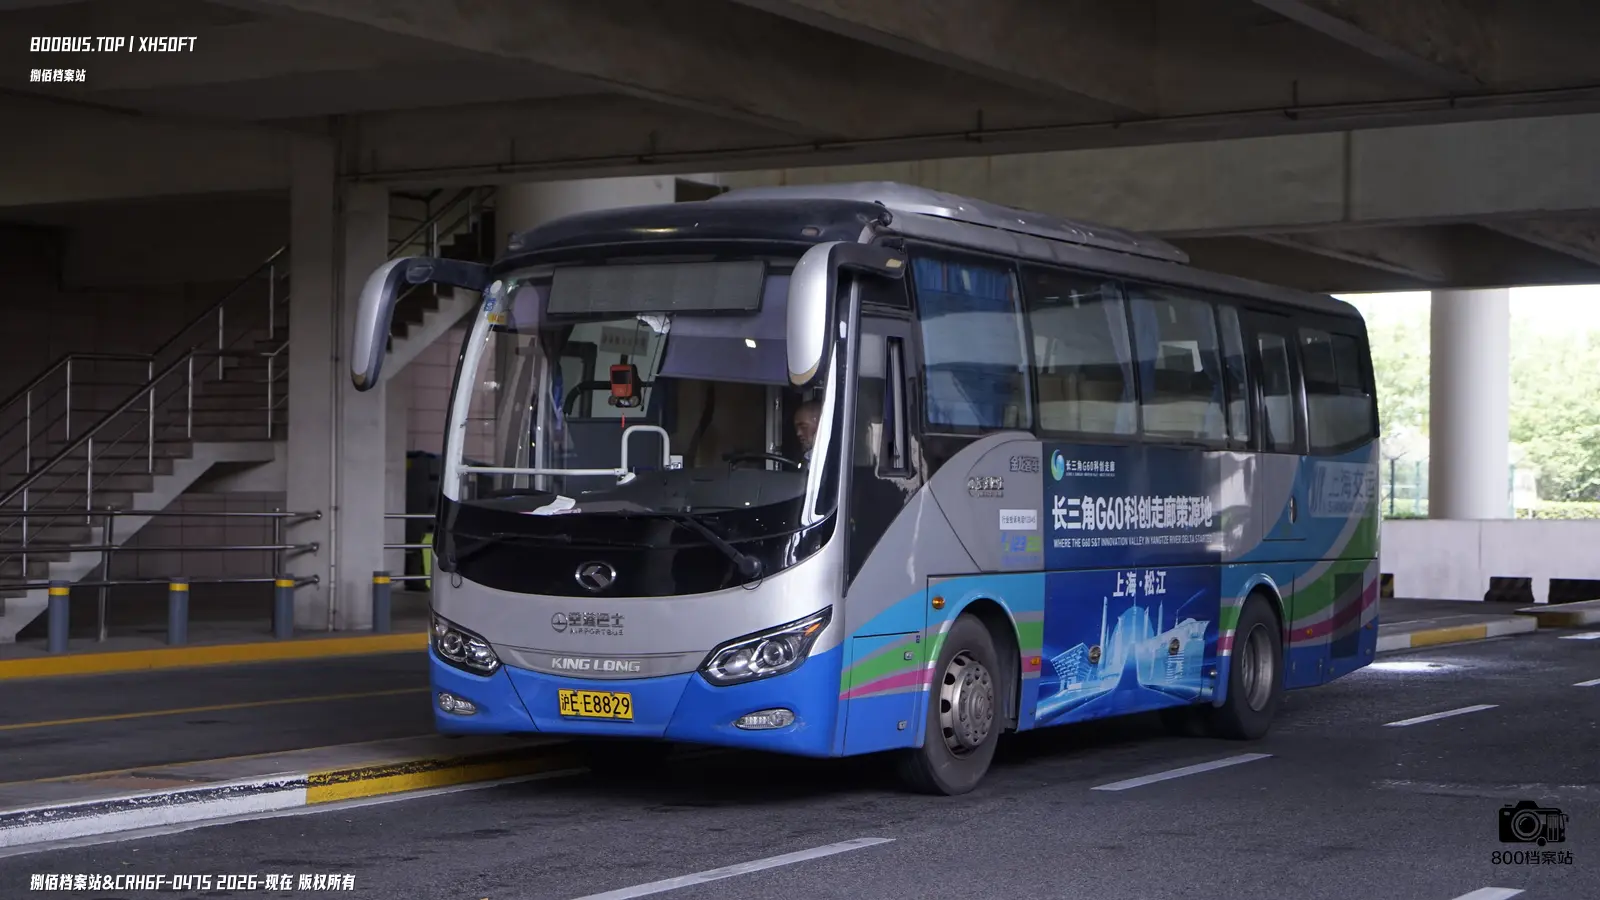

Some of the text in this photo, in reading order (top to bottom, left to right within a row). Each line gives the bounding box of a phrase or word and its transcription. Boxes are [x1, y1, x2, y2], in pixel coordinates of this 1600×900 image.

[1066, 460, 1116, 472] 长三角G60科创走廊
[1052, 495, 1213, 531] 长三角G60科创走廊策源地
[1053, 538, 1071, 548] WHERE
[1072, 538, 1081, 548] THE
[1082, 537, 1091, 547] G60
[1091, 537, 1101, 547] S&T
[1101, 536, 1128, 546] INNOVATION
[1129, 536, 1144, 545] VALLEY
[1145, 536, 1150, 545] IN
[1170, 535, 1181, 544] RIVER
[1182, 535, 1194, 544] DELTA
[551, 657, 640, 672] KING LONG
